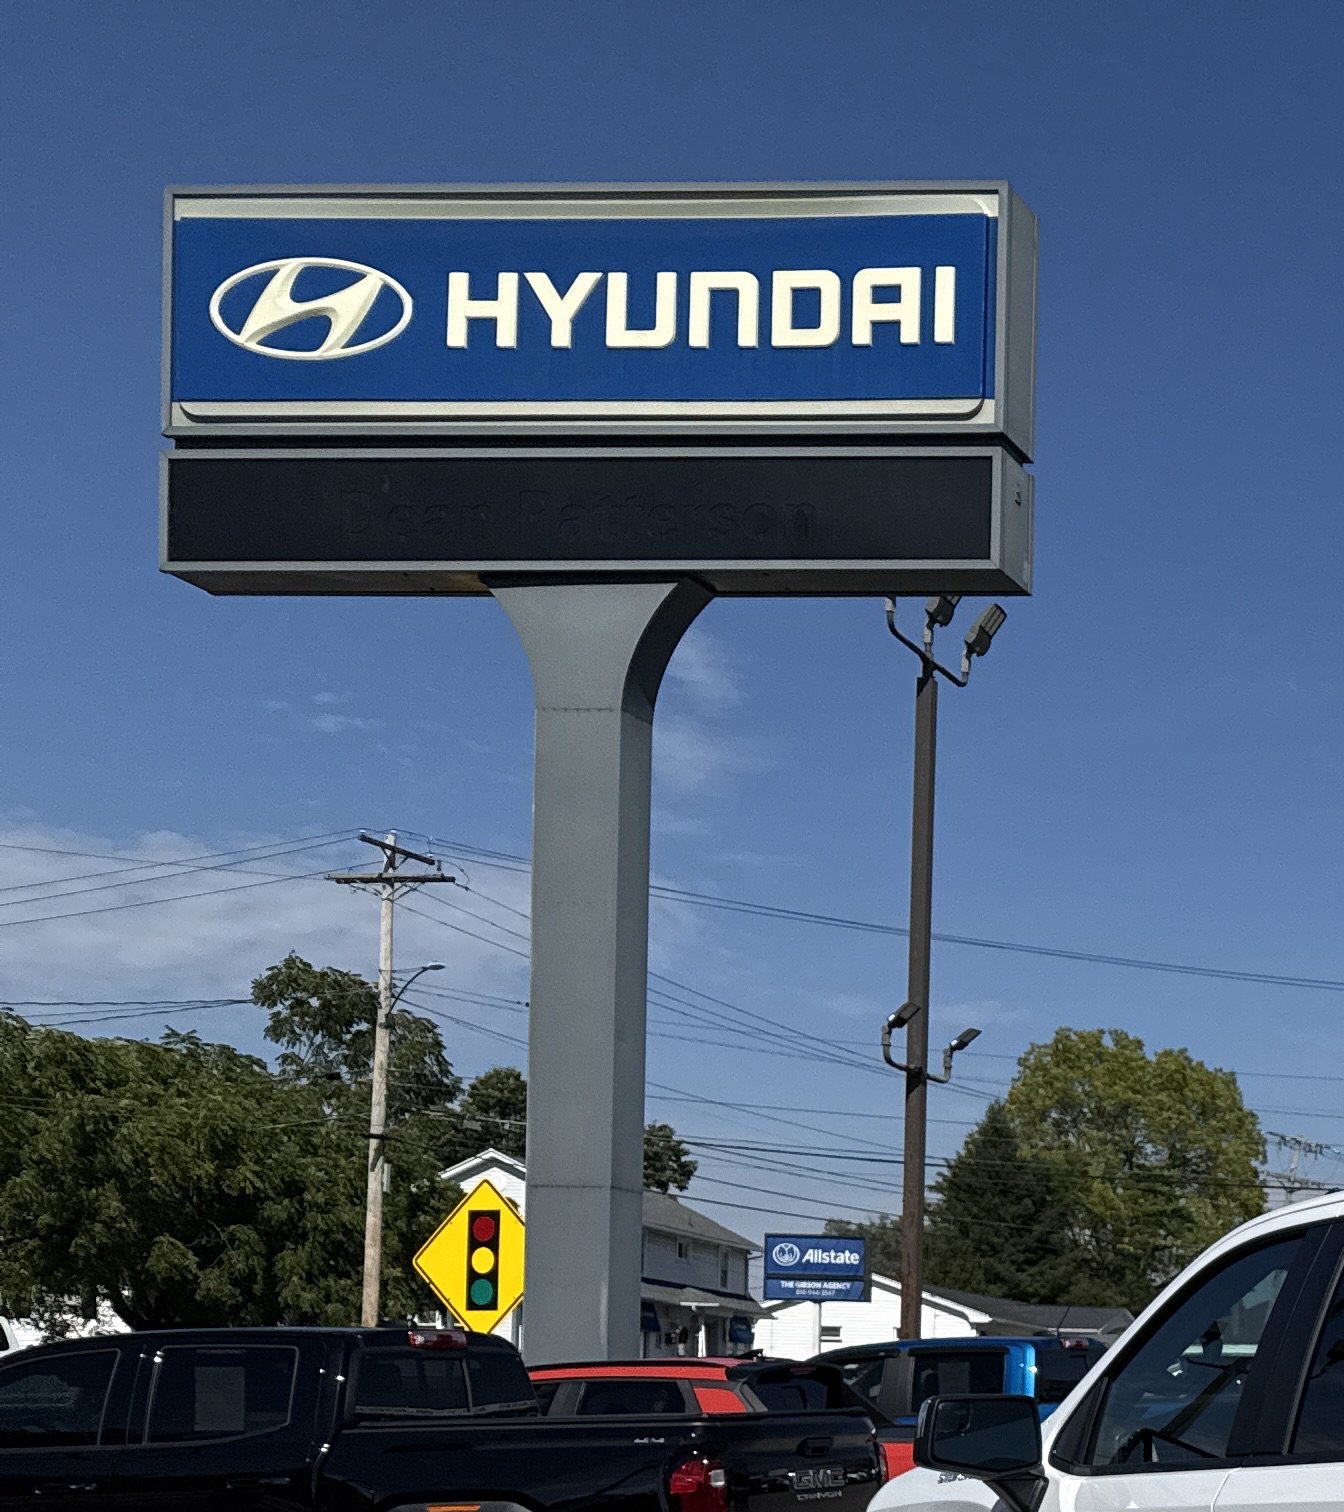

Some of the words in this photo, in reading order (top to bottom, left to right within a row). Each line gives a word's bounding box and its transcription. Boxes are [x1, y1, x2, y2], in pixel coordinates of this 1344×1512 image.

[446, 265, 956, 349] HYUNDAI
[802, 1248, 860, 1265] Allstate
[780, 1281, 794, 1289] THE
[822, 1282, 852, 1290] AGENCY
[793, 1467, 846, 1490] GMC
